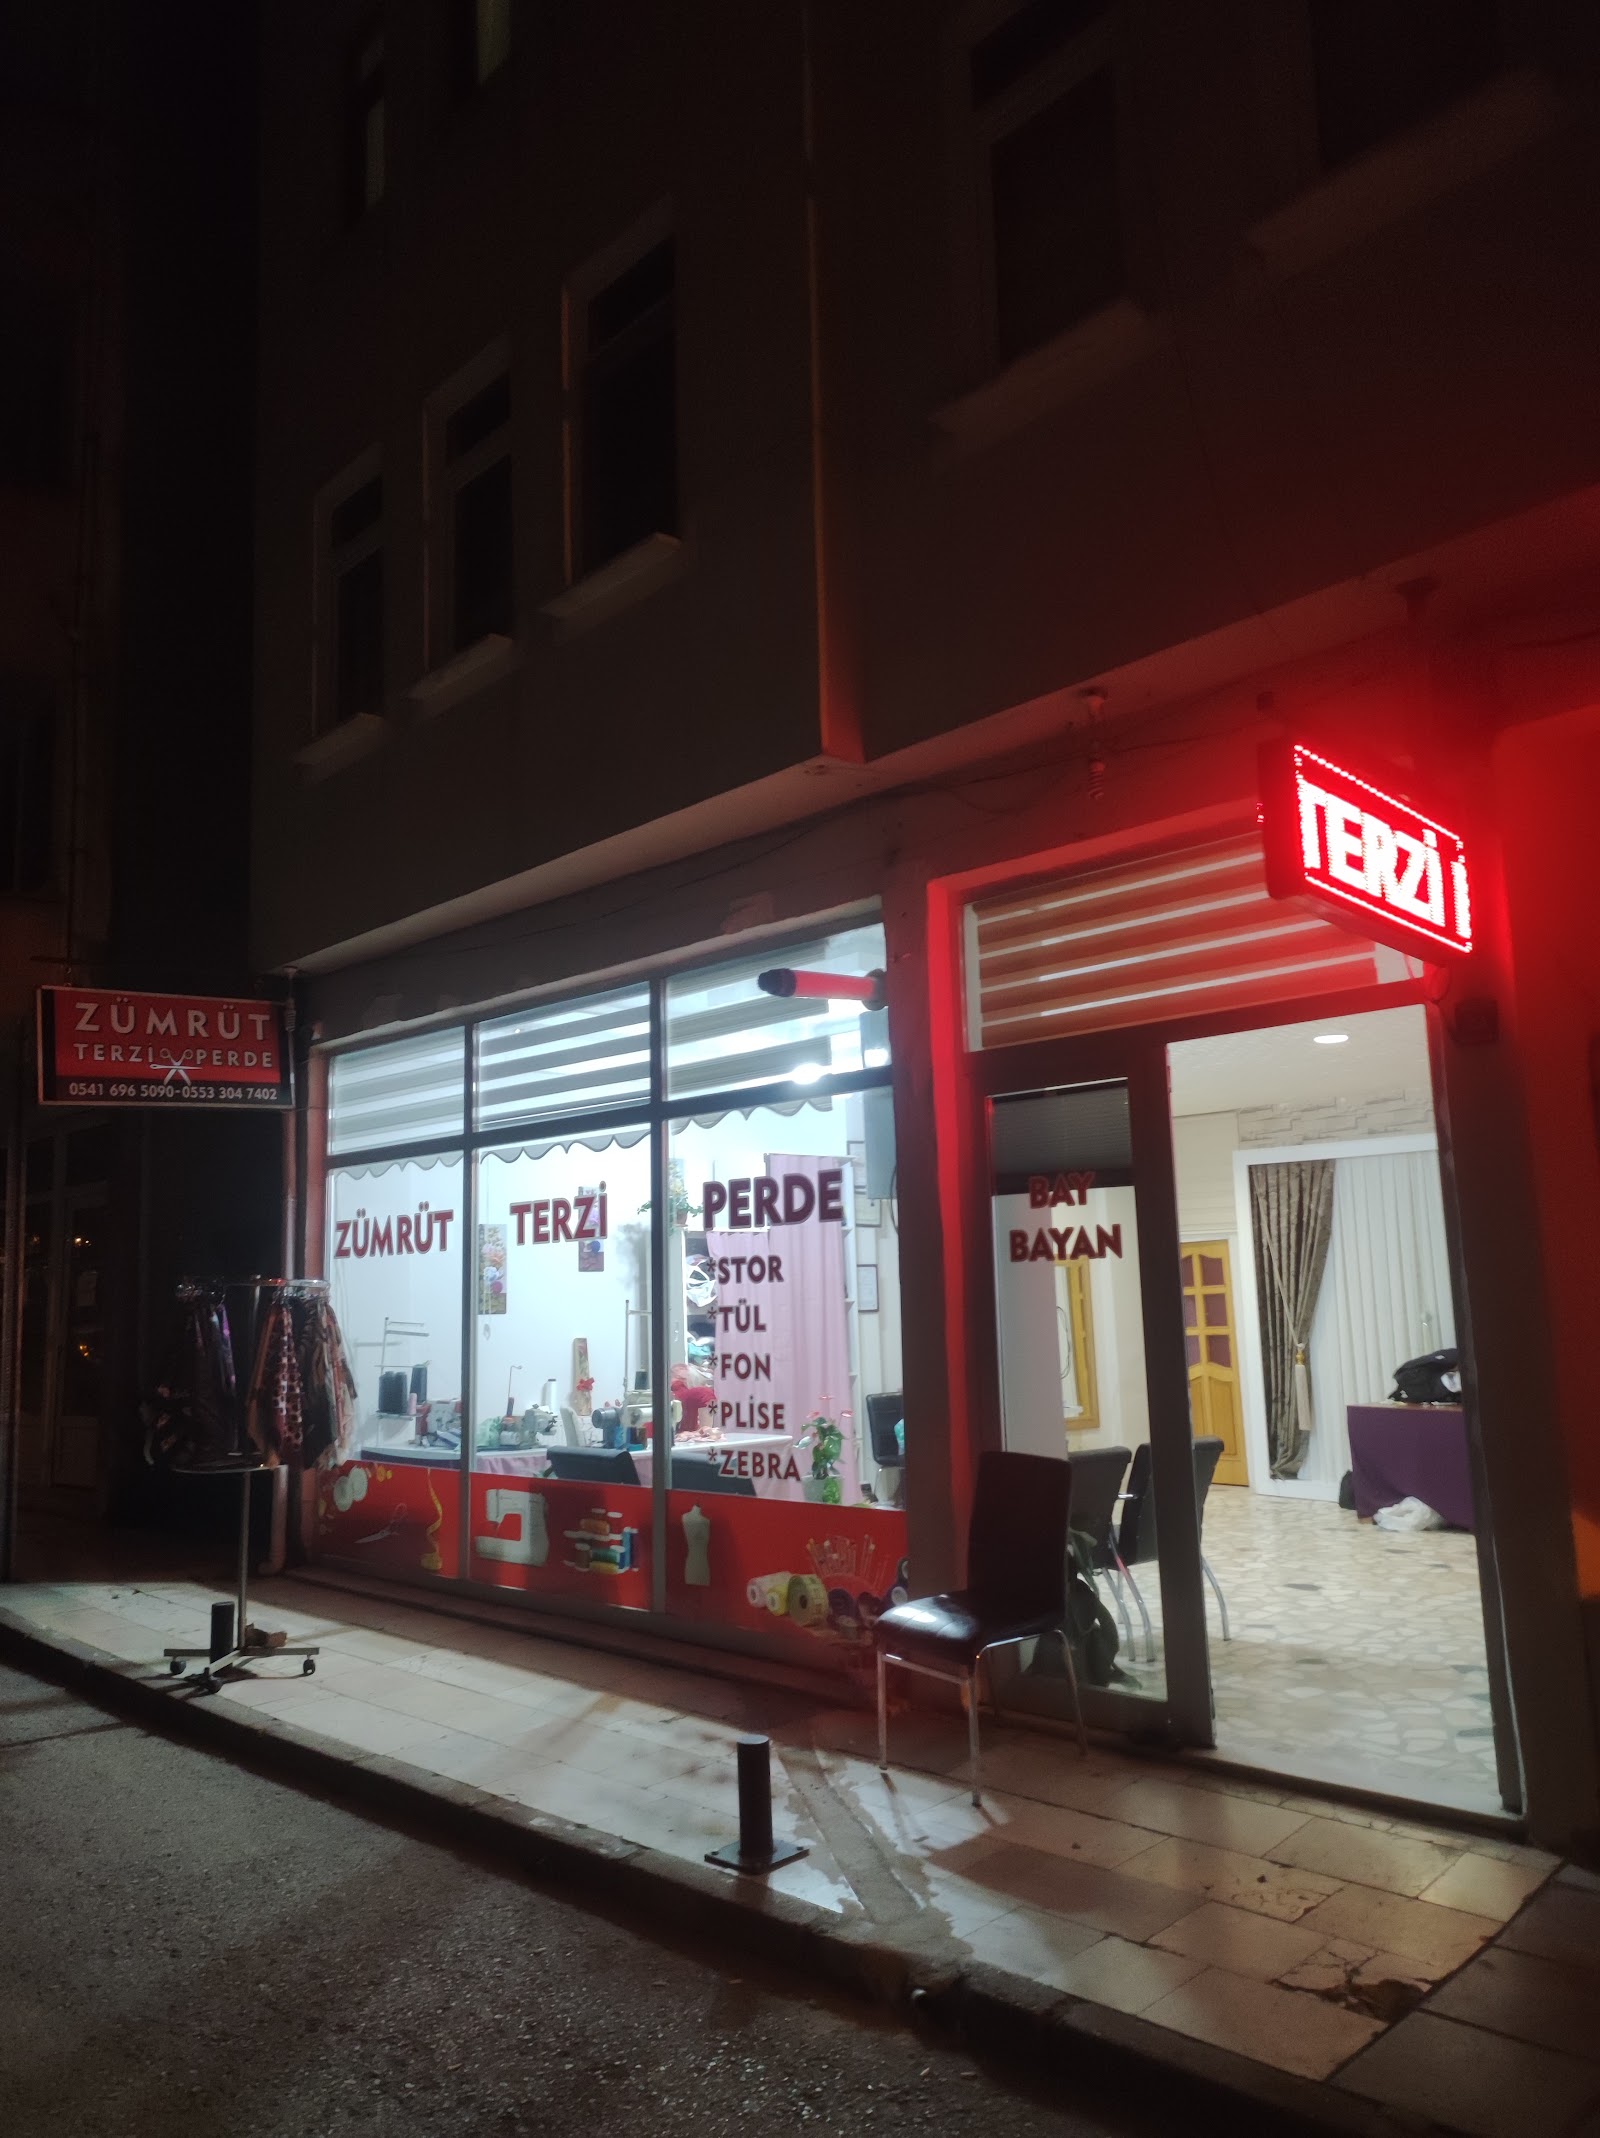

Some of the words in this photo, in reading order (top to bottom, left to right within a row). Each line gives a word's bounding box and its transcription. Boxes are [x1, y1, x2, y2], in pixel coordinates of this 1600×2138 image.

[1297, 778, 1446, 928] TERZİ
[74, 996, 271, 1041] ZÜMRÜT
[73, 1042, 154, 1063] TERZİ
[196, 1048, 273, 1068] PERDE
[69, 1082, 104, 1097] 0541
[109, 1084, 136, 1098] 696
[219, 1086, 243, 1100] 304
[246, 1087, 278, 1101] 7402
[1028, 1171, 1096, 1209] BAY
[334, 1201, 454, 1259] ZÜMRÜT
[509, 1181, 608, 1246] TERZİ
[702, 1168, 843, 1231] PERDE
[1009, 1223, 1123, 1262] BAYAN
